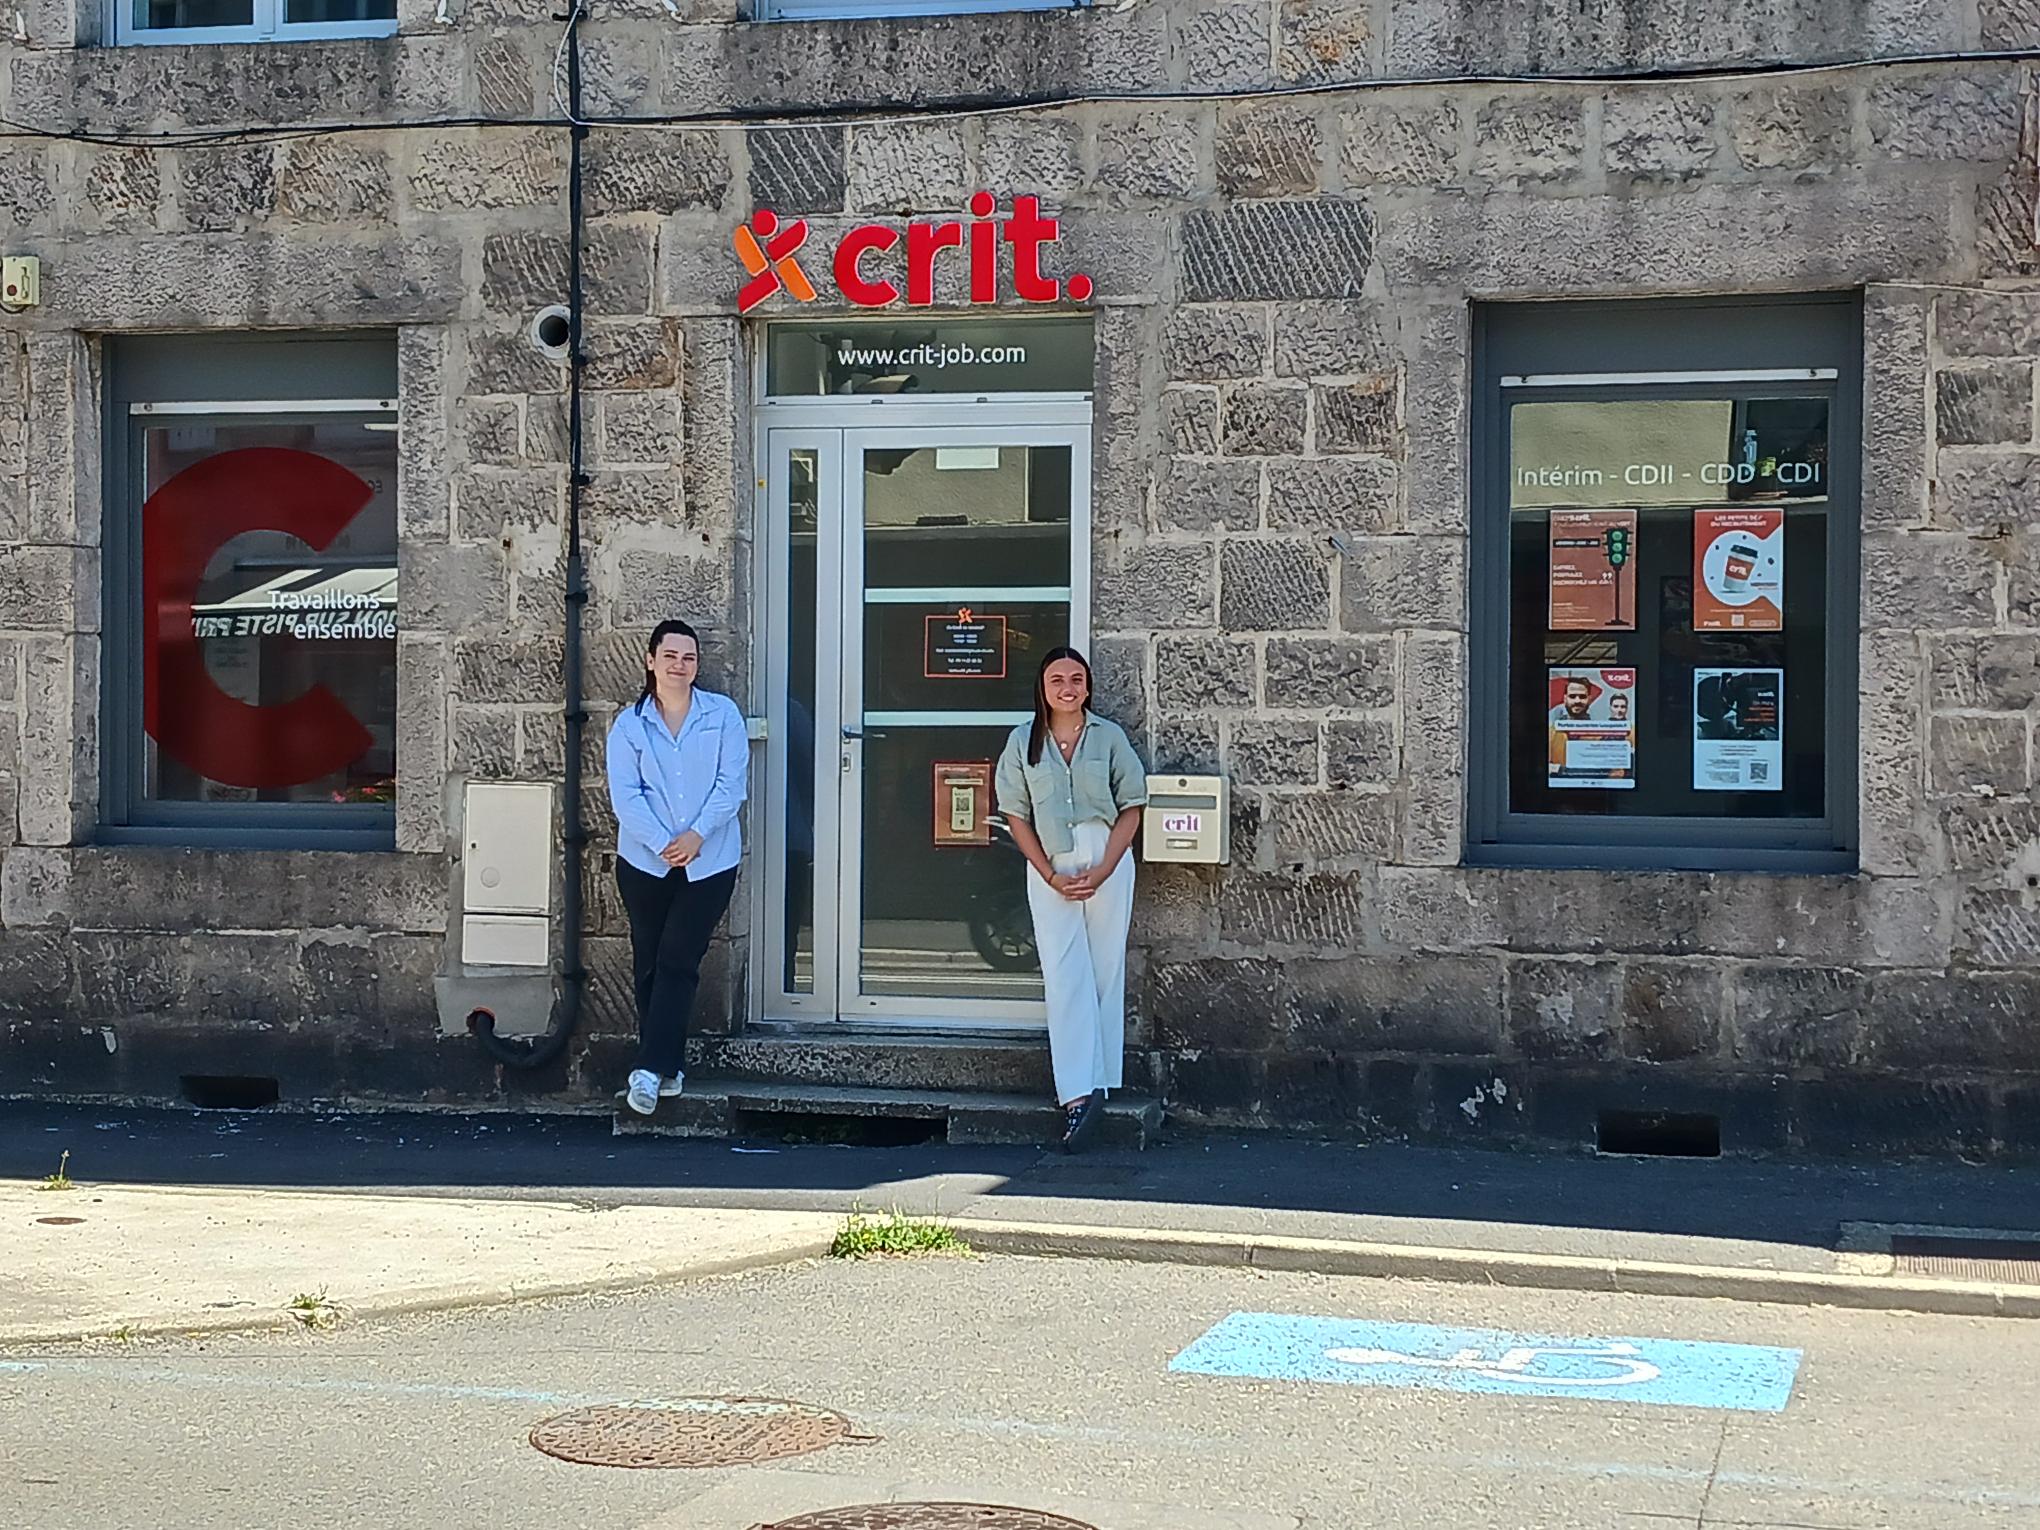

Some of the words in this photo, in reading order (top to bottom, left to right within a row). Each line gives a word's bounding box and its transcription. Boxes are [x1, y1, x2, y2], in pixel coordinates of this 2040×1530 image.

[832, 190, 1094, 307] crit.
[837, 343, 1026, 368] www.crit-job.com
[1517, 465, 1603, 487] Intérim
[1624, 464, 1674, 485] CDII
[1700, 463, 1756, 484] CDD
[1777, 463, 1820, 484] CDI
[267, 588, 380, 609] Travaillons
[294, 619, 396, 640] ensemble
